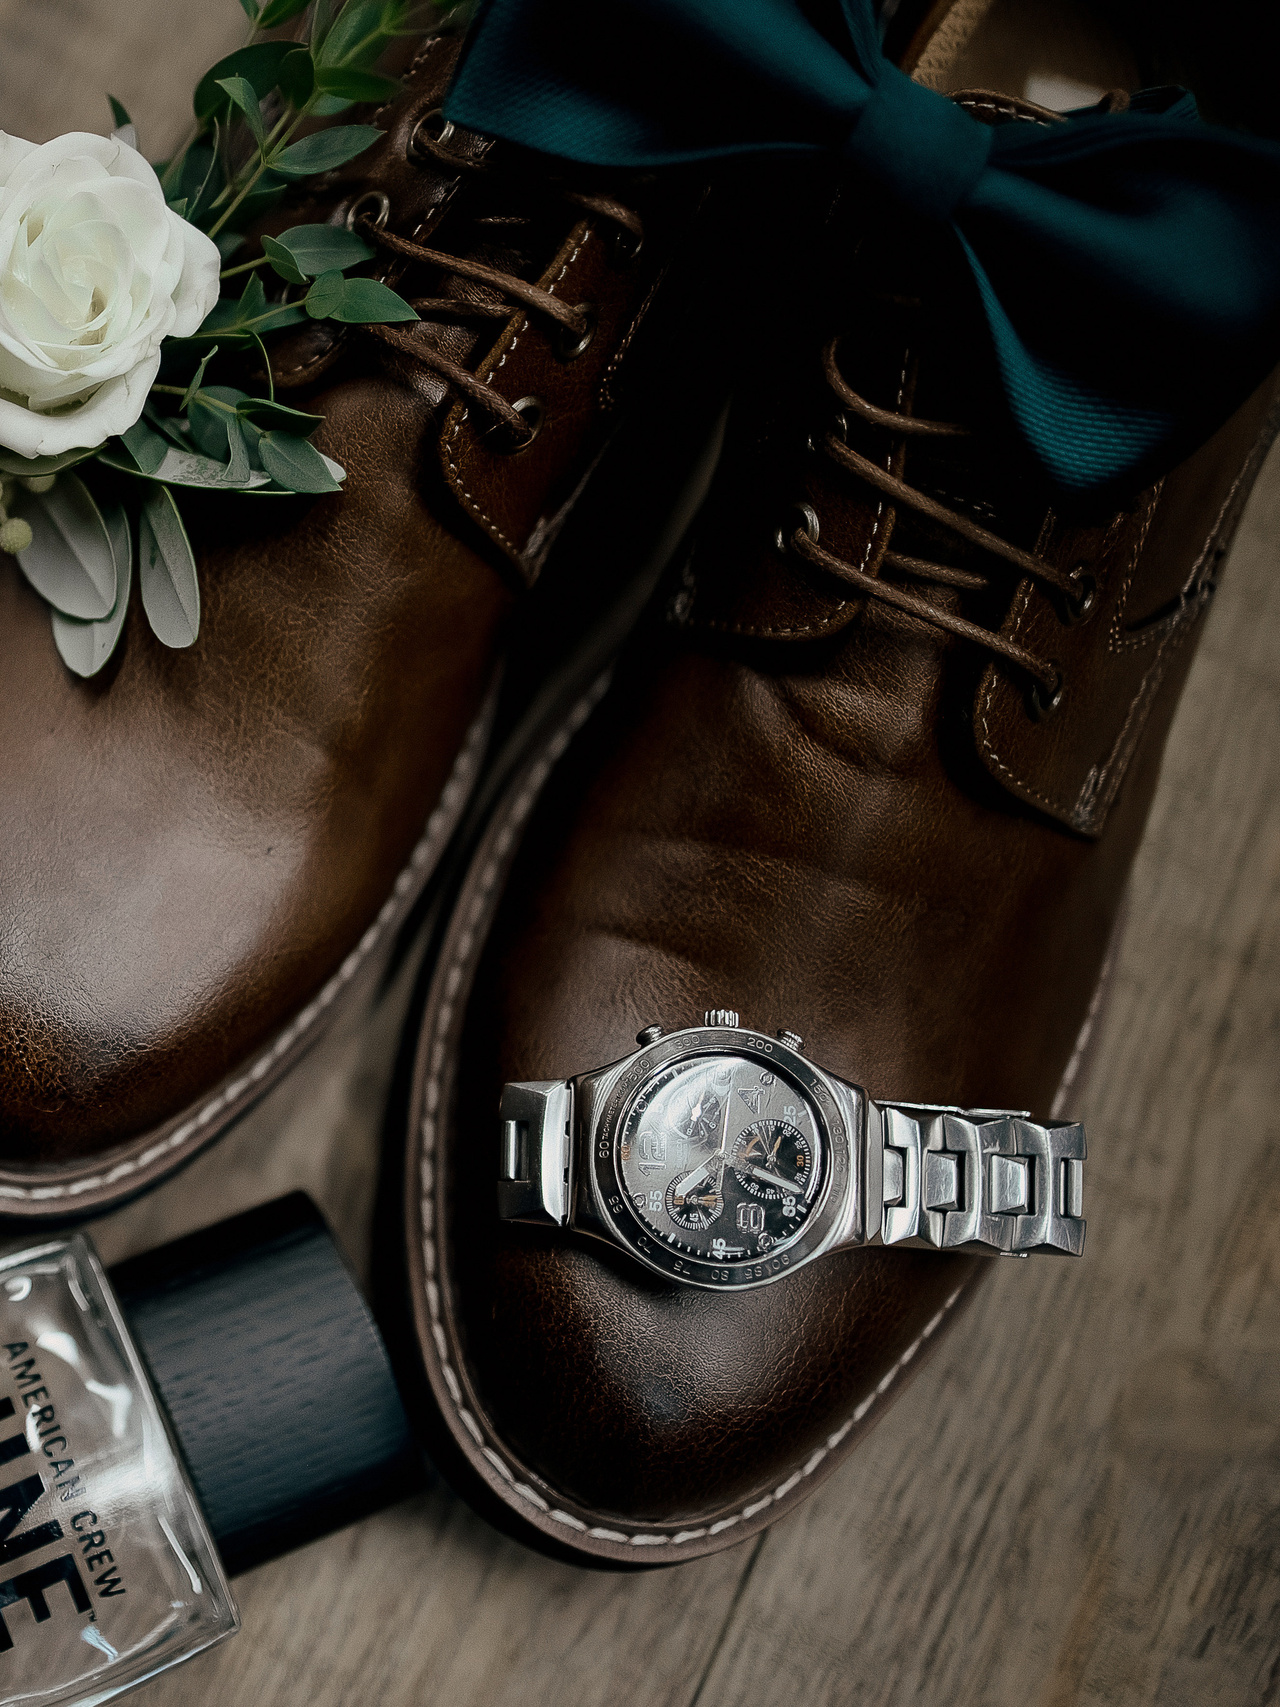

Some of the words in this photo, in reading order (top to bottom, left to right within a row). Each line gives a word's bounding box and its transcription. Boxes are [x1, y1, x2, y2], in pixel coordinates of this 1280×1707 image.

[674, 1034, 700, 1048] 300
[746, 1037, 773, 1052] 200
[809, 1079, 828, 1102] 150
[599, 1140, 610, 1159] 60
[796, 1154, 805, 1167] 30
[608, 1195, 624, 1214] 65
[649, 1190, 663, 1212] 55
[689, 1212, 699, 1222] 45
[637, 1236, 654, 1254] 70
[712, 1238, 727, 1260] 45
[673, 1260, 691, 1275] 75
[772, 1254, 790, 1269] 90
[711, 1269, 729, 1281] 80
[745, 1266, 763, 1280] 85
[2, 1341, 86, 1502] AMERICAN
[70, 1510, 126, 1598] CREW
